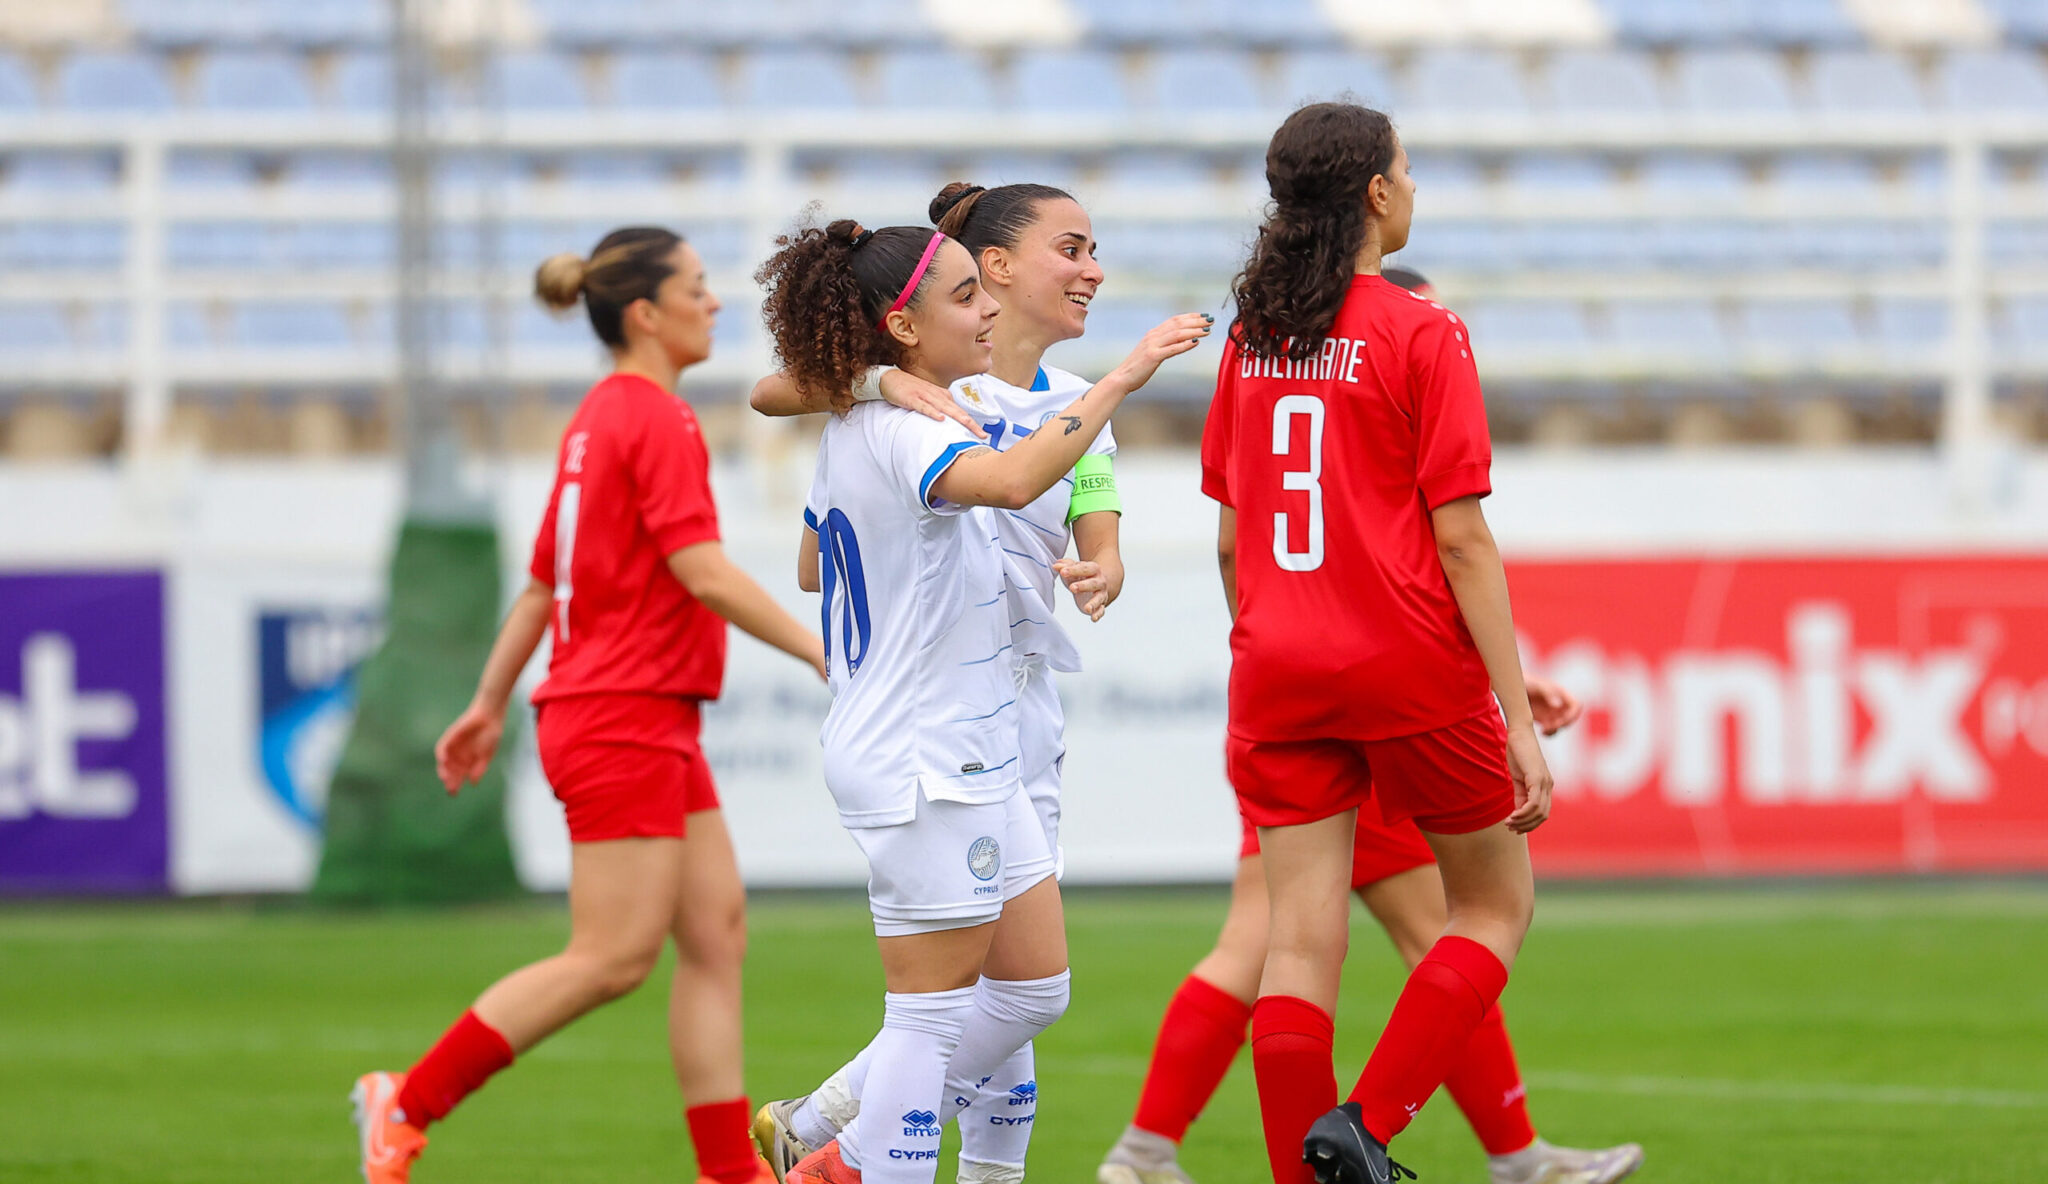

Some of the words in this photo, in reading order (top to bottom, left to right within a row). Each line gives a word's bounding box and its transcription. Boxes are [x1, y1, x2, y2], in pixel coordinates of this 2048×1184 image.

[1272, 394, 1325, 572] 3
[973, 884, 999, 895] CYPRUS
[889, 1149, 940, 1160] CYPRU
